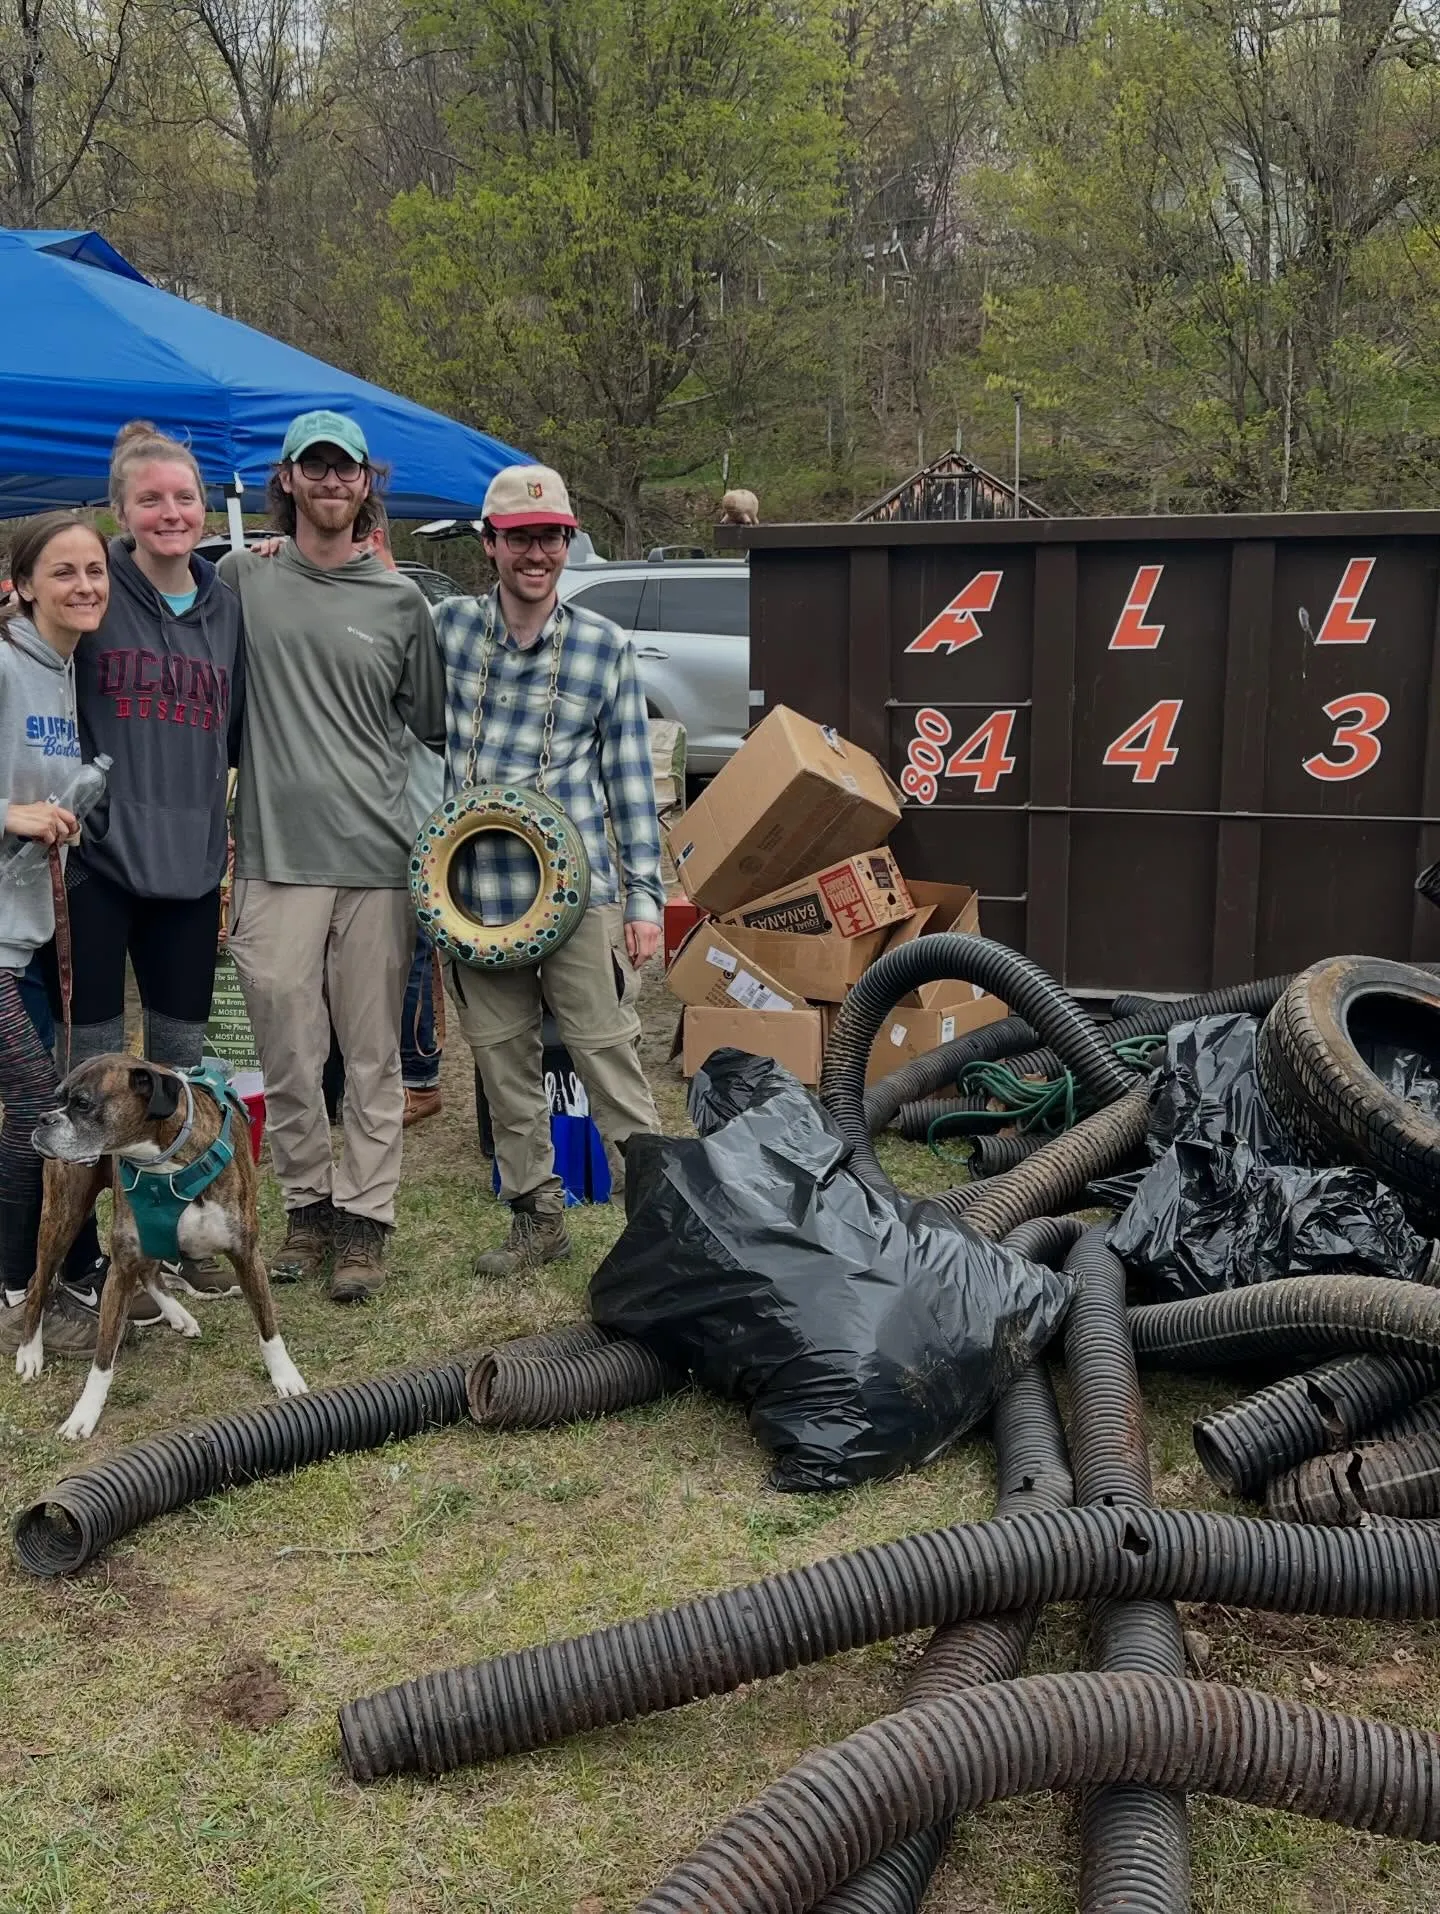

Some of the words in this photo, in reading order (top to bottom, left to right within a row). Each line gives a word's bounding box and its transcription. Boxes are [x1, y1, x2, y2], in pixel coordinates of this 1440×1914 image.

[115, 697, 223, 730] HUSKIE
[26, 715, 77, 741] SUFFI
[900, 707, 952, 805] 800
[226, 998, 247, 1006] Bronz
[217, 1008, 237, 1016] MOST
[232, 1023, 252, 1033] Plung
[215, 1033, 234, 1041] MOST
[227, 1047, 245, 1055] Trout
[249, 1059, 261, 1067] TIR
